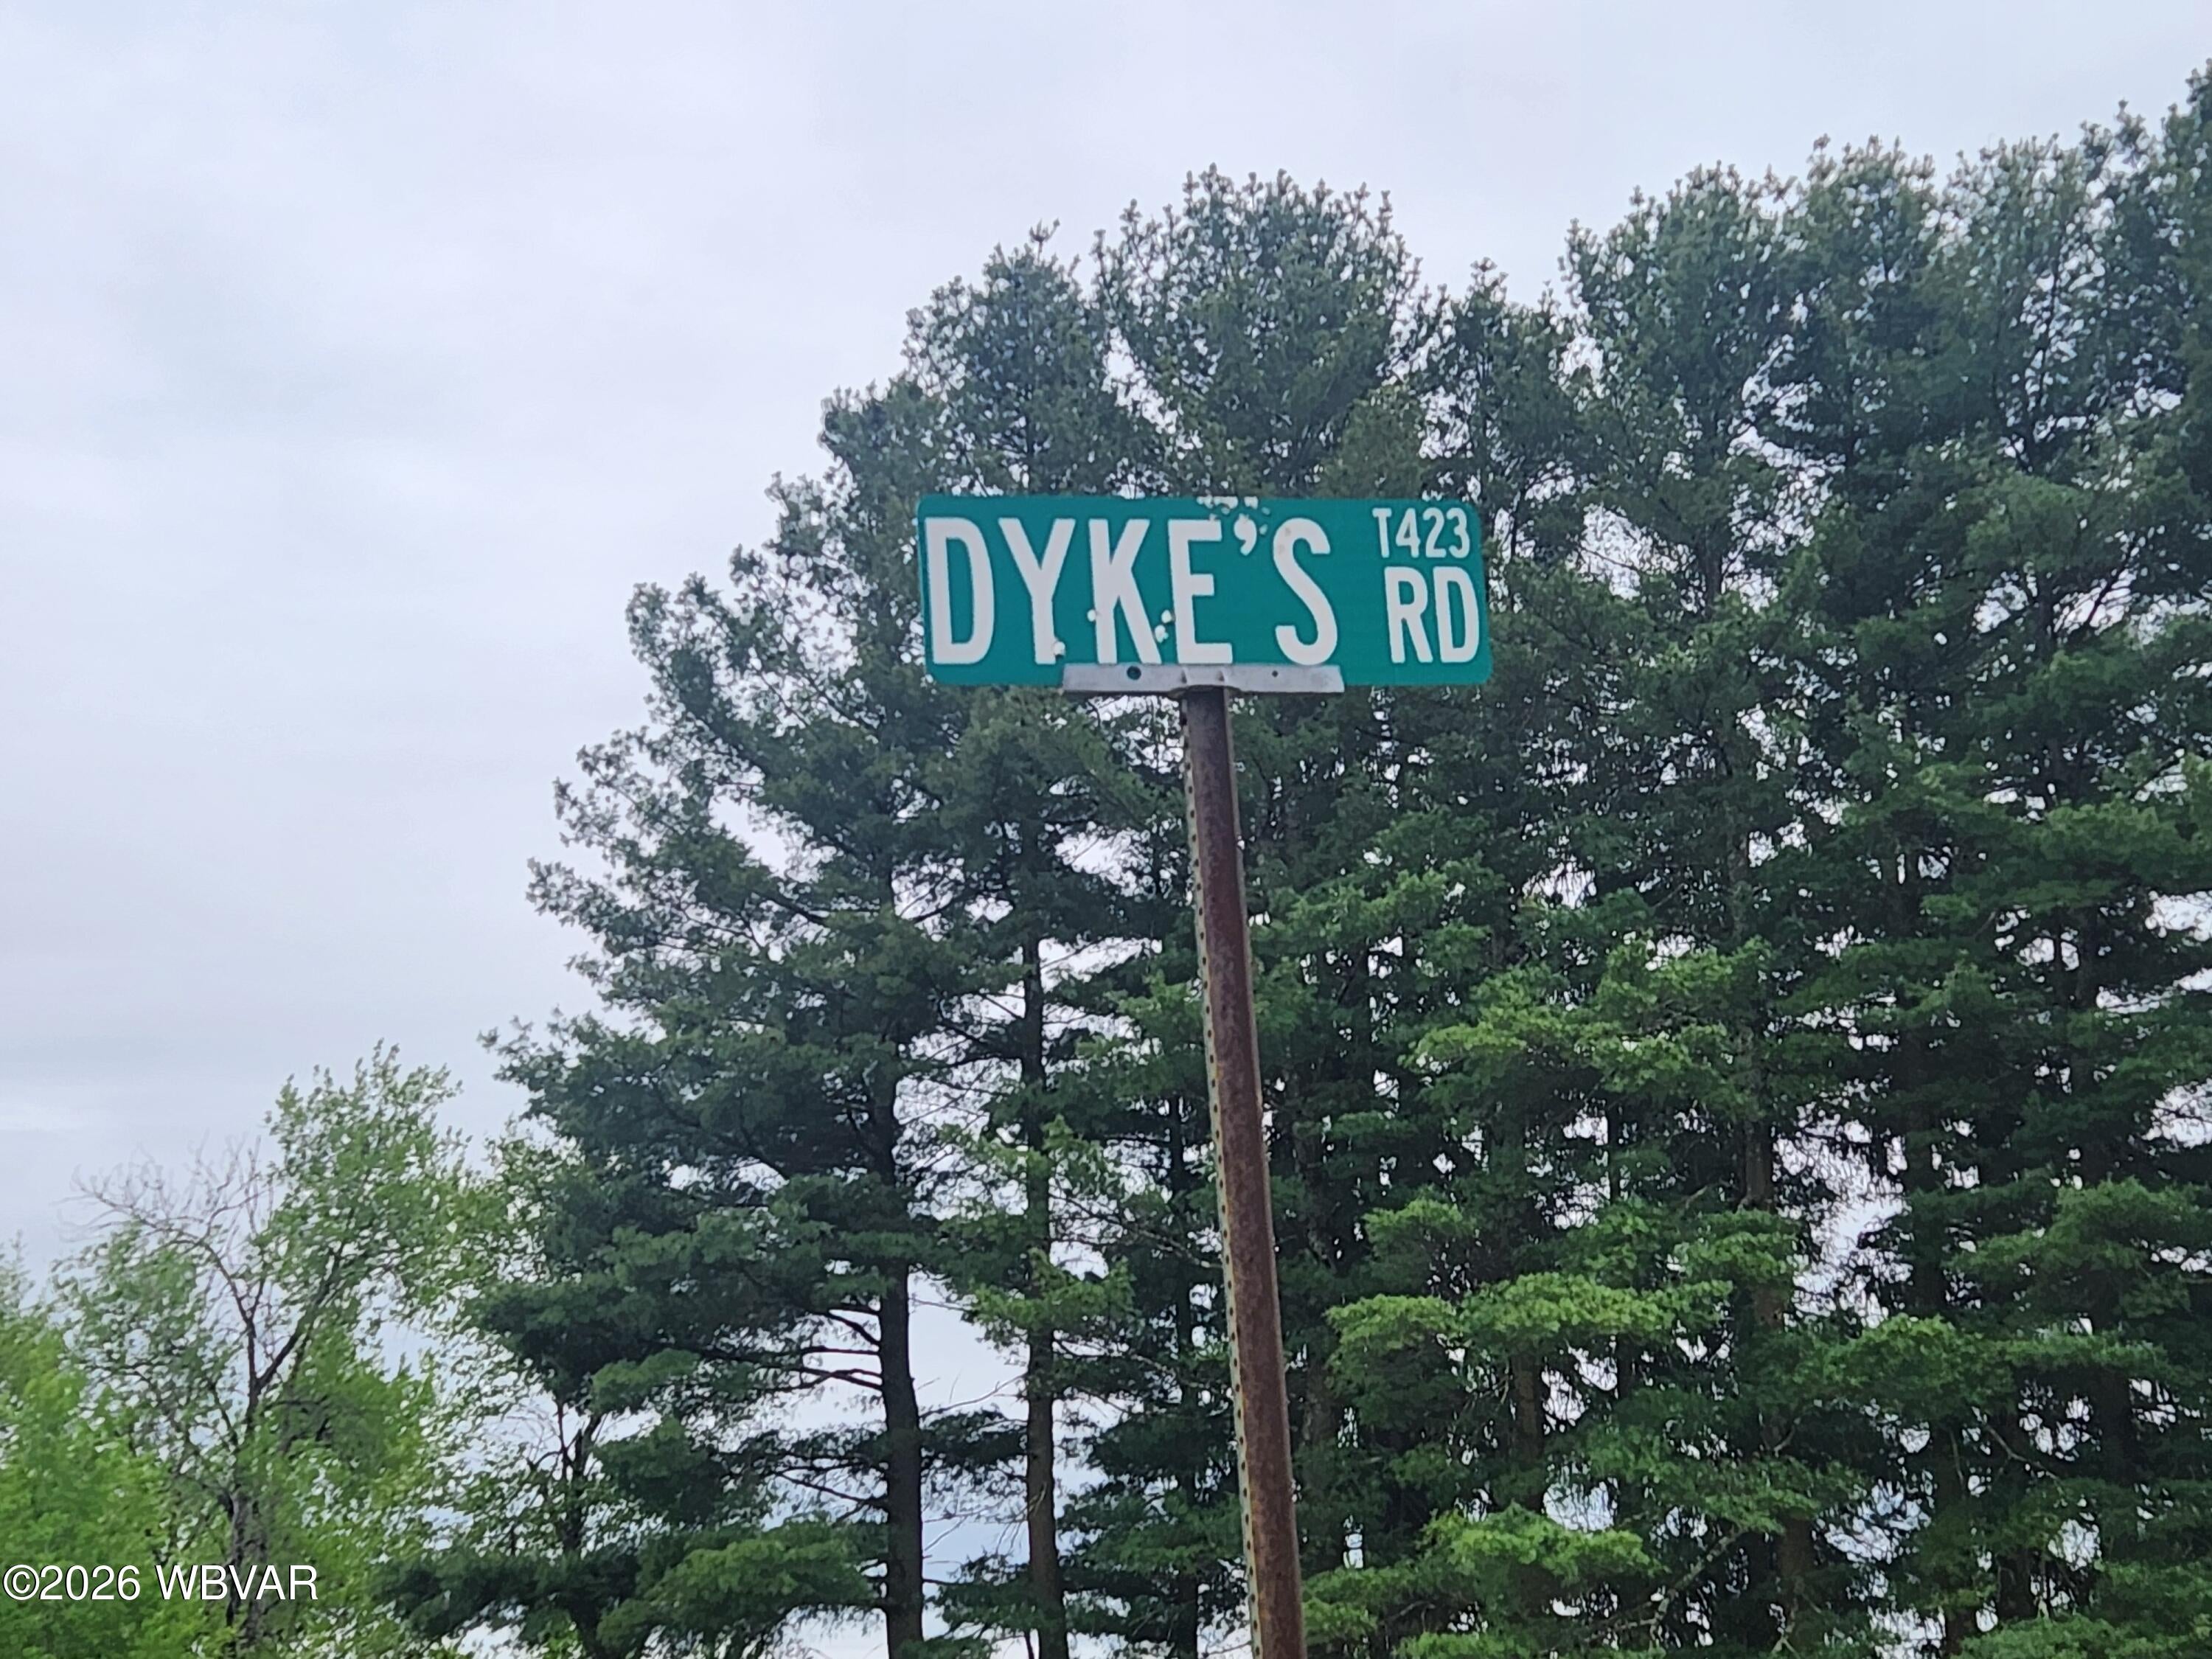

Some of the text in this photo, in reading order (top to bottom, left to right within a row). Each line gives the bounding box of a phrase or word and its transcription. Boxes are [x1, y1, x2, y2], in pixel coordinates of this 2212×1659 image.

[1372, 507, 1470, 558] T423
[925, 517, 1479, 666] DYKE'S RD
